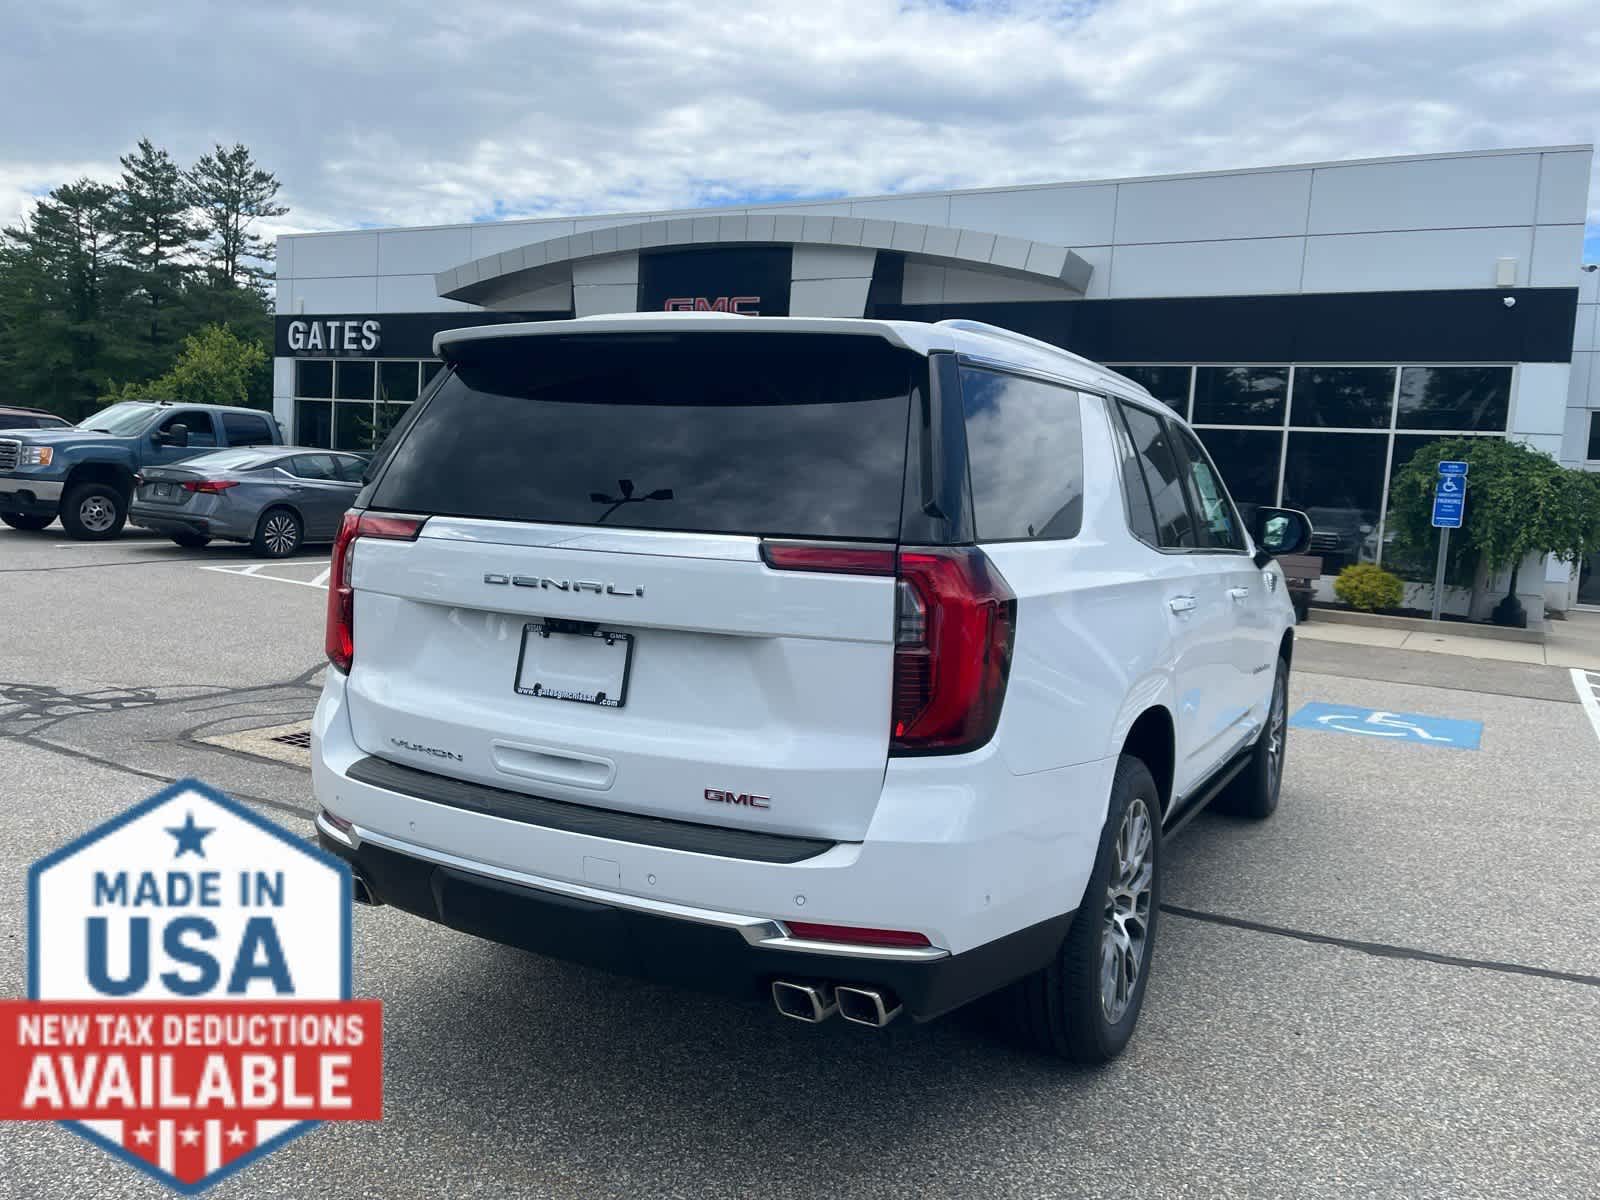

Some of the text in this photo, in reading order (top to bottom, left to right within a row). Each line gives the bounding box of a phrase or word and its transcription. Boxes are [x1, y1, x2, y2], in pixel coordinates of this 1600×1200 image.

[664, 296, 760, 317] GMC
[287, 320, 381, 350] GATES
[484, 573, 645, 597] DENALI
[609, 632, 628, 640] GMC
[391, 738, 464, 762] YUKON
[704, 788, 771, 809] GMC
